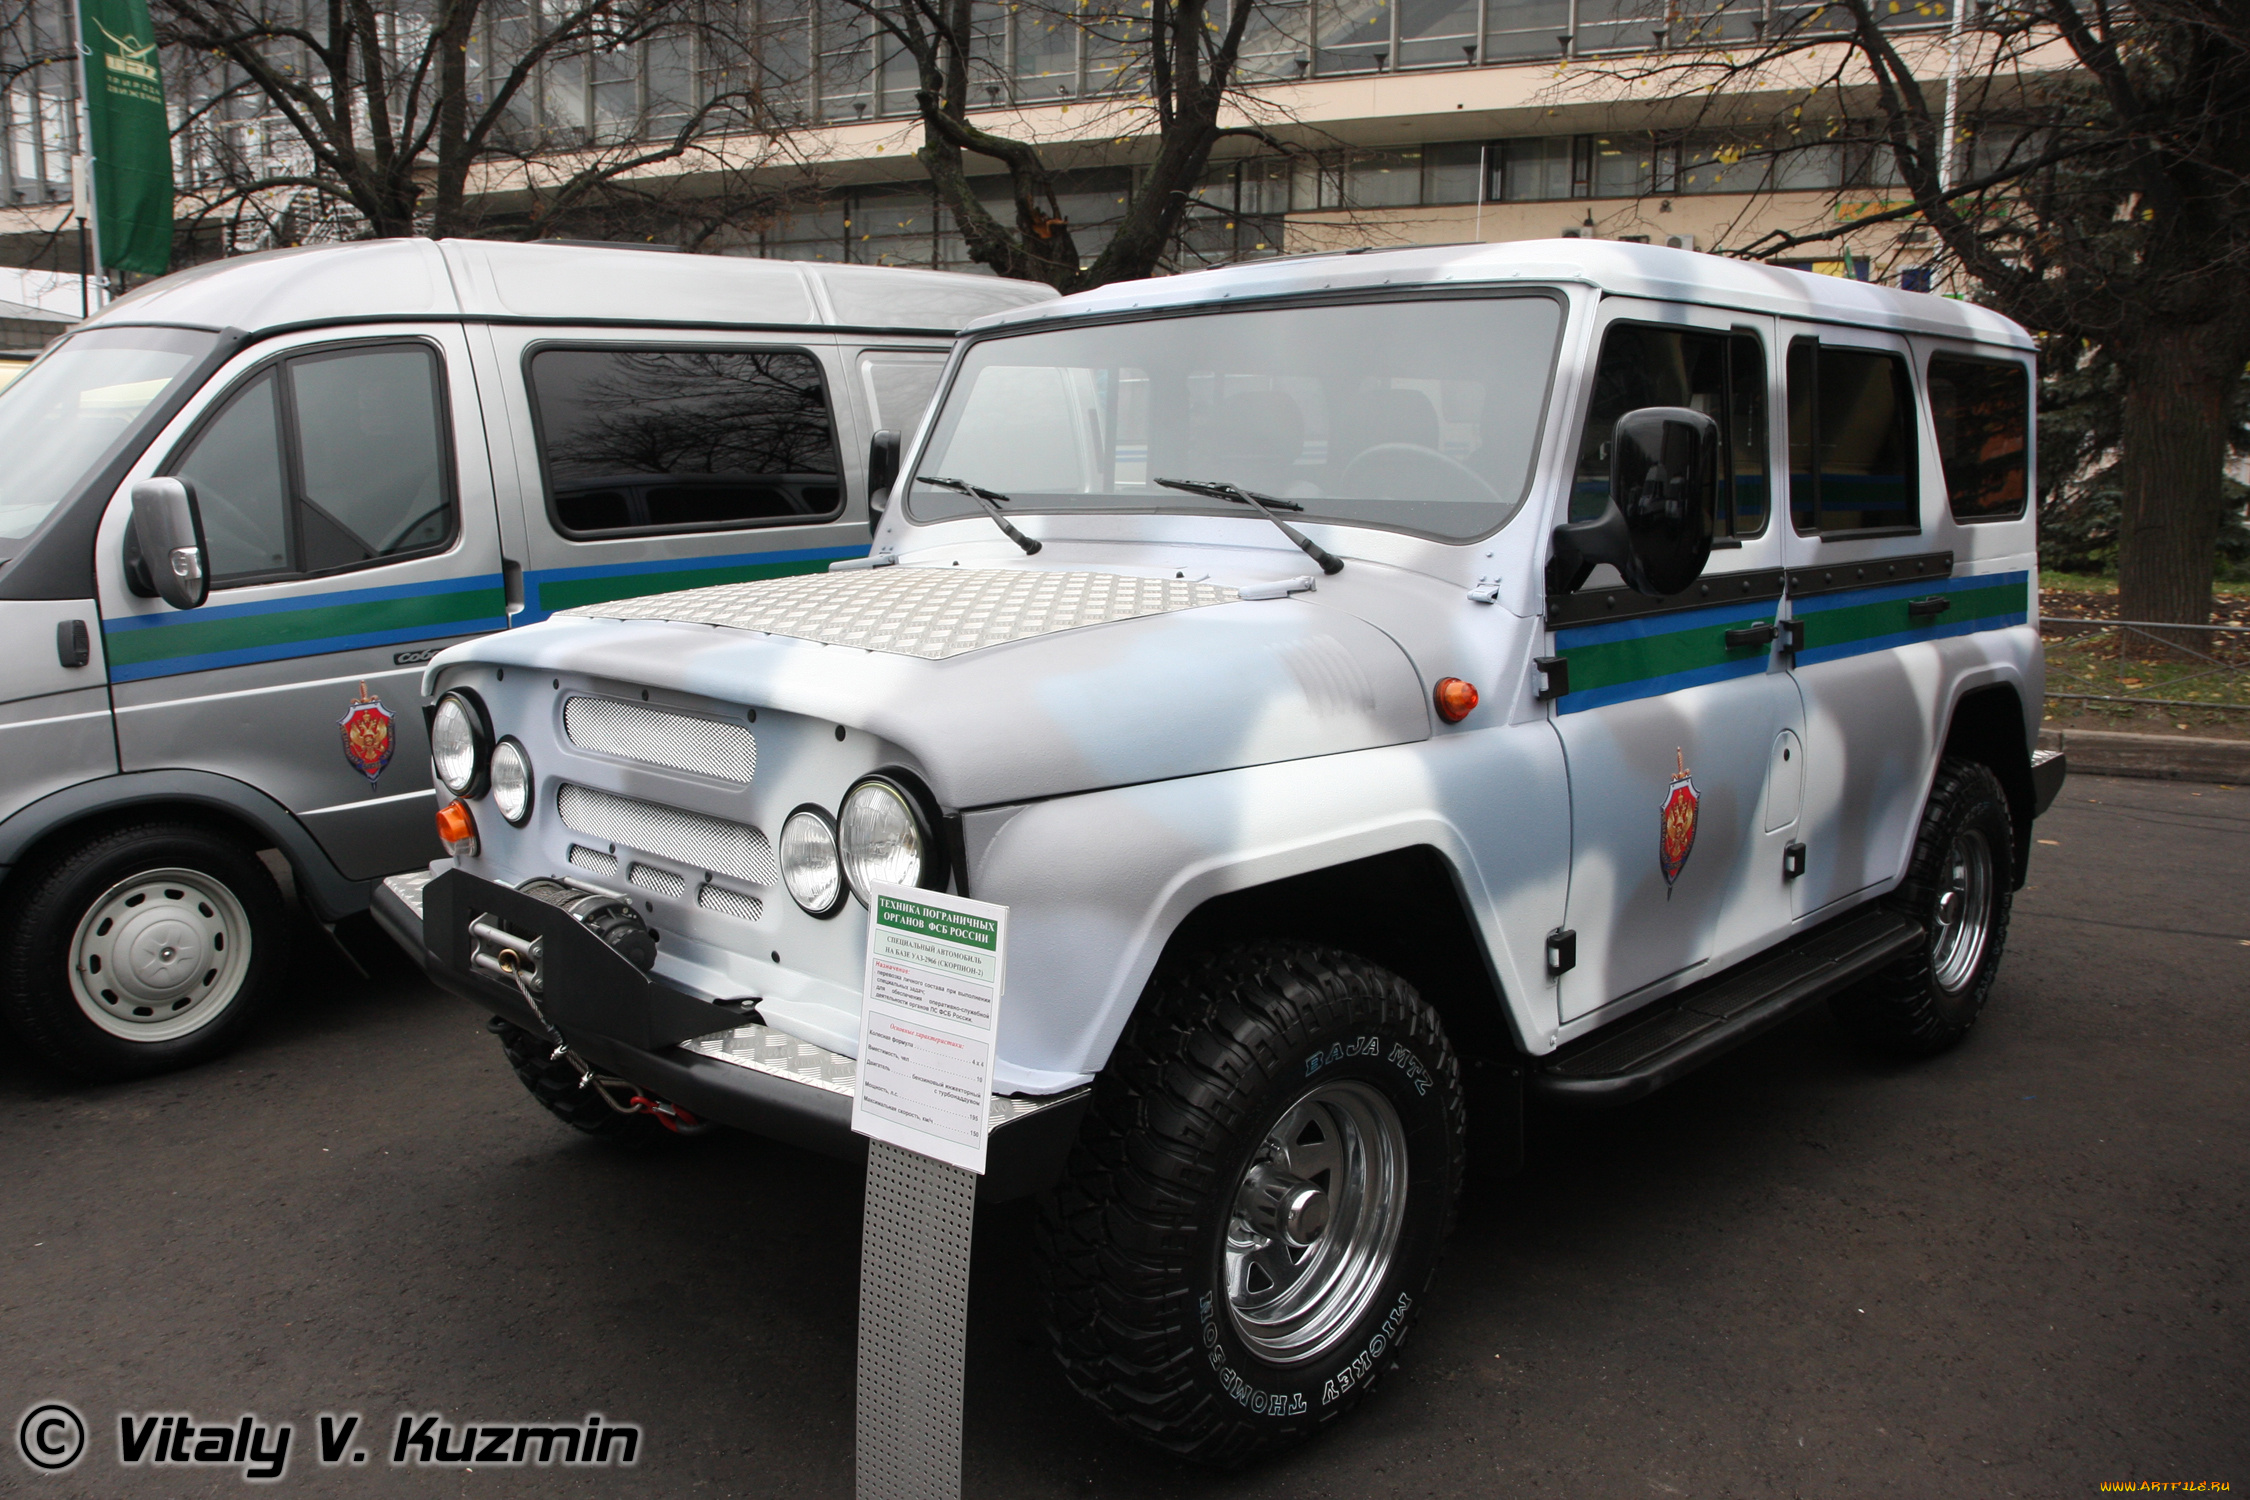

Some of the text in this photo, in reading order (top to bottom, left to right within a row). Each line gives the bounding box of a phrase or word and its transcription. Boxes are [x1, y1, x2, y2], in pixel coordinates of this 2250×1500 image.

[880, 898, 995, 932] ТЕХНИКА ПОГРАНИЧНЫХ
[884, 912, 988, 943] ОРГАНОВ ФСБ РОССИИ
[885, 946, 894, 954] НА
[895, 949, 910, 958] БАЗЕ
[938, 960, 984, 977] (СКОРПИОН-2)
[886, 936, 982, 964] СПЕЦИАЛЬНЫЙ АВТОМОБИЛЬ
[876, 961, 910, 974] Назначение:
[876, 978, 908, 990] специальных
[877, 970, 990, 1003] перевозка личного состава при выполнении
[876, 992, 972, 1022] деятельности органов ПС ФСБ России.
[892, 989, 922, 1001] обеспечения
[928, 999, 990, 1019] оперативно-служебной
[870, 1029, 891, 1040] Колесная
[892, 1036, 914, 1048] формула
[890, 1024, 914, 1036] Основные
[868, 1044, 900, 1059] Вместимость,
[1305, 1036, 1434, 1096] BAJA MTZ
[865, 1081, 889, 1095] Мощность,
[866, 1059, 981, 1098] Двигатель бензиновый инжекторный
[864, 1096, 897, 1112] Максимальная
[938, 1090, 980, 1106] турбонаддувом
[1199, 1290, 1412, 1416] MICKEY THOMPSON
